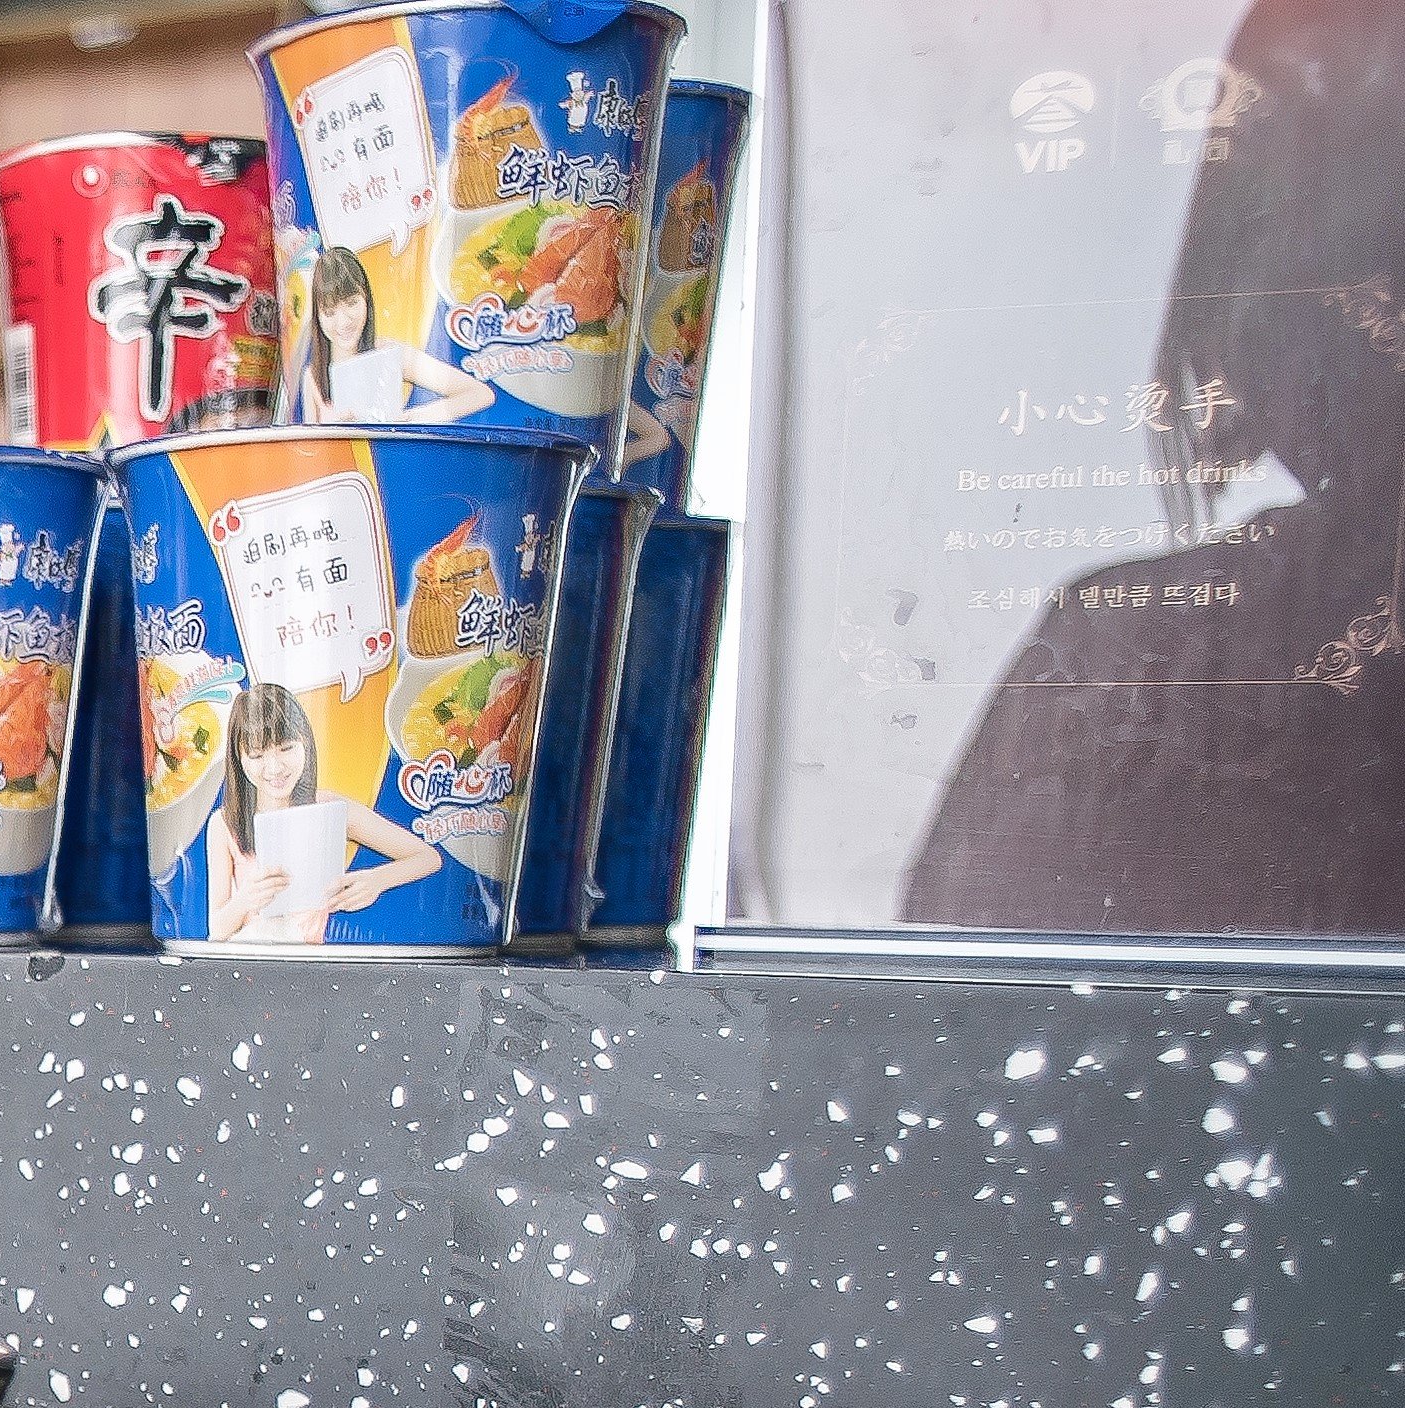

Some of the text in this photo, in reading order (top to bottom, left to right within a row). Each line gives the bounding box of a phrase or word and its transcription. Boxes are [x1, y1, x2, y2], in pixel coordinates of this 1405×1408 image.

[1014, 138, 1086, 174] VIP
[96, 200, 246, 416] 辛
[997, 377, 1237, 436] 小心烫手
[956, 458, 1267, 491] Be careful the hot drinks
[296, 556, 348, 592] 有面
